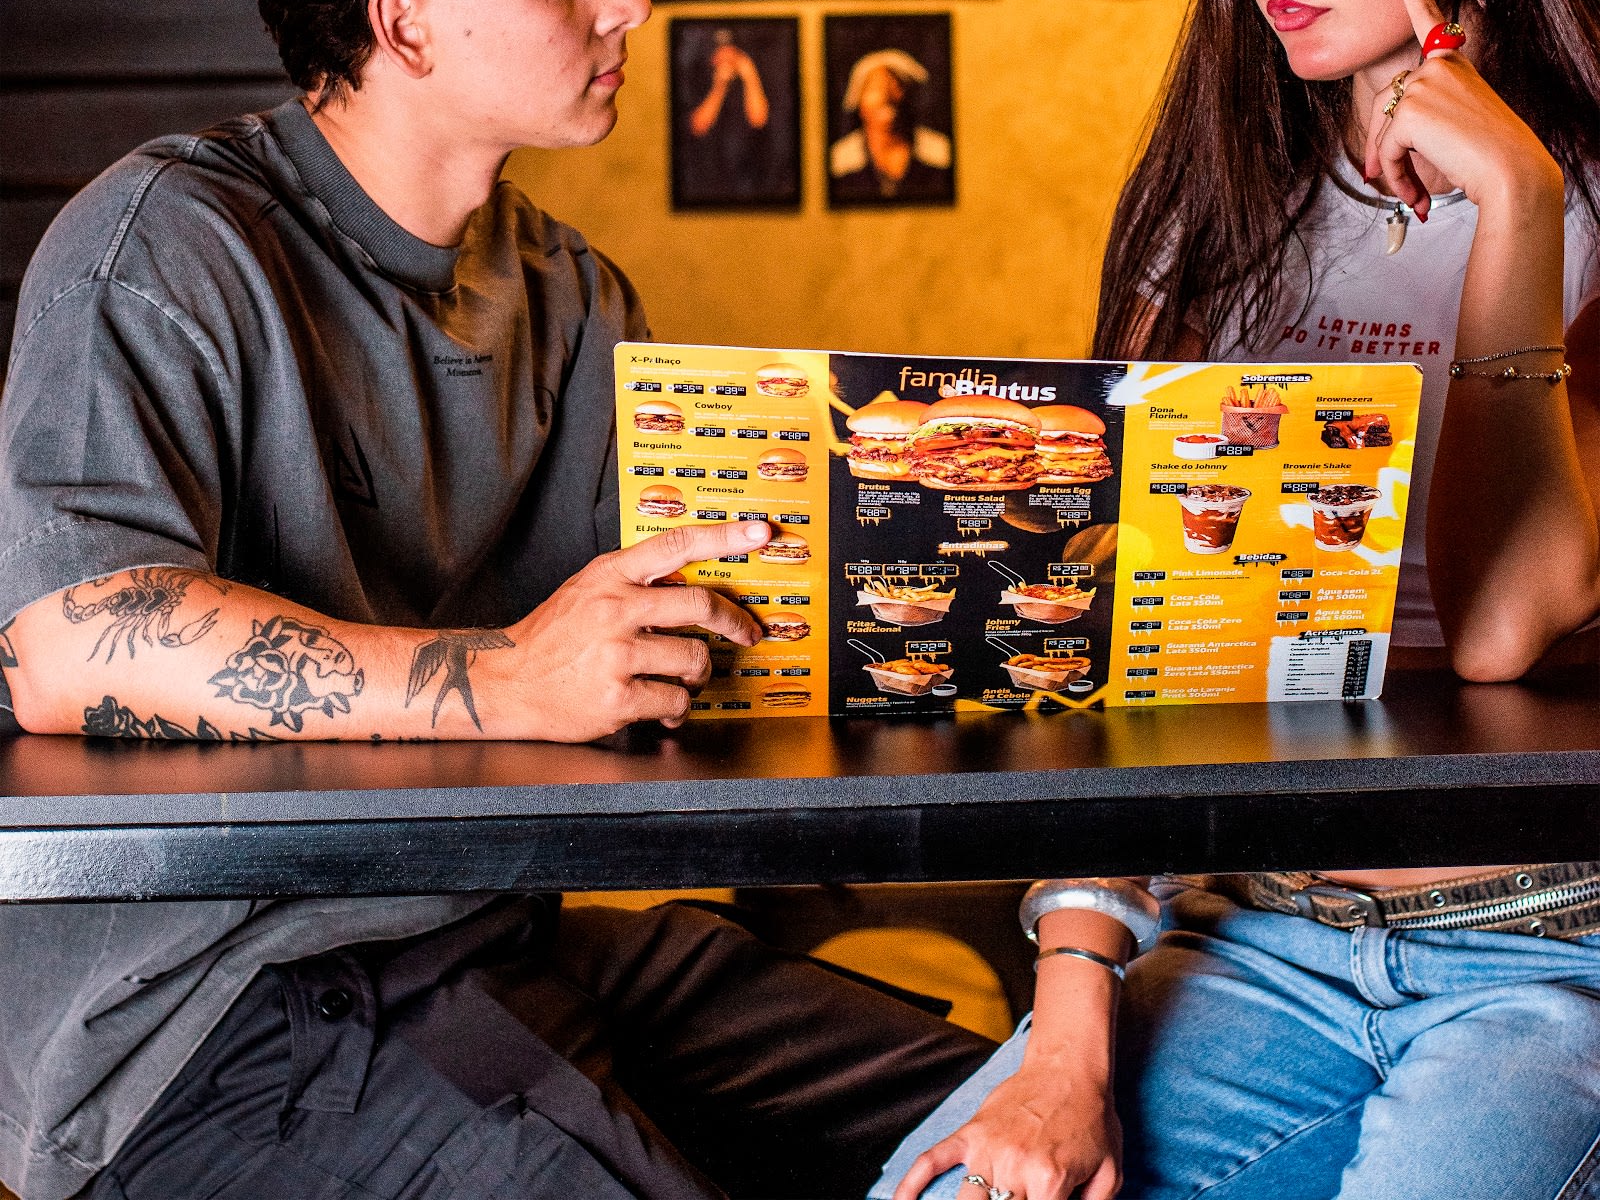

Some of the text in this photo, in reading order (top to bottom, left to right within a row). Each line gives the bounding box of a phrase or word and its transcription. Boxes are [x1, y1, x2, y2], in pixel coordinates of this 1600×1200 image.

[1318, 316, 1412, 337] LATINAS
[1317, 335, 1340, 350] IT
[1350, 340, 1441, 356] BETTER
[899, 366, 997, 391] família
[1242, 374, 1311, 382] Sobremesas
[955, 379, 1057, 401] Brutus
[694, 402, 733, 411] Cowboy
[633, 441, 682, 450] Burguinho
[696, 486, 744, 494] Cremosão
[858, 483, 891, 491] Brutus
[1073, 487, 1092, 495] Egg
[942, 542, 1005, 550] Entradinhas
[714, 570, 732, 578] Egg
